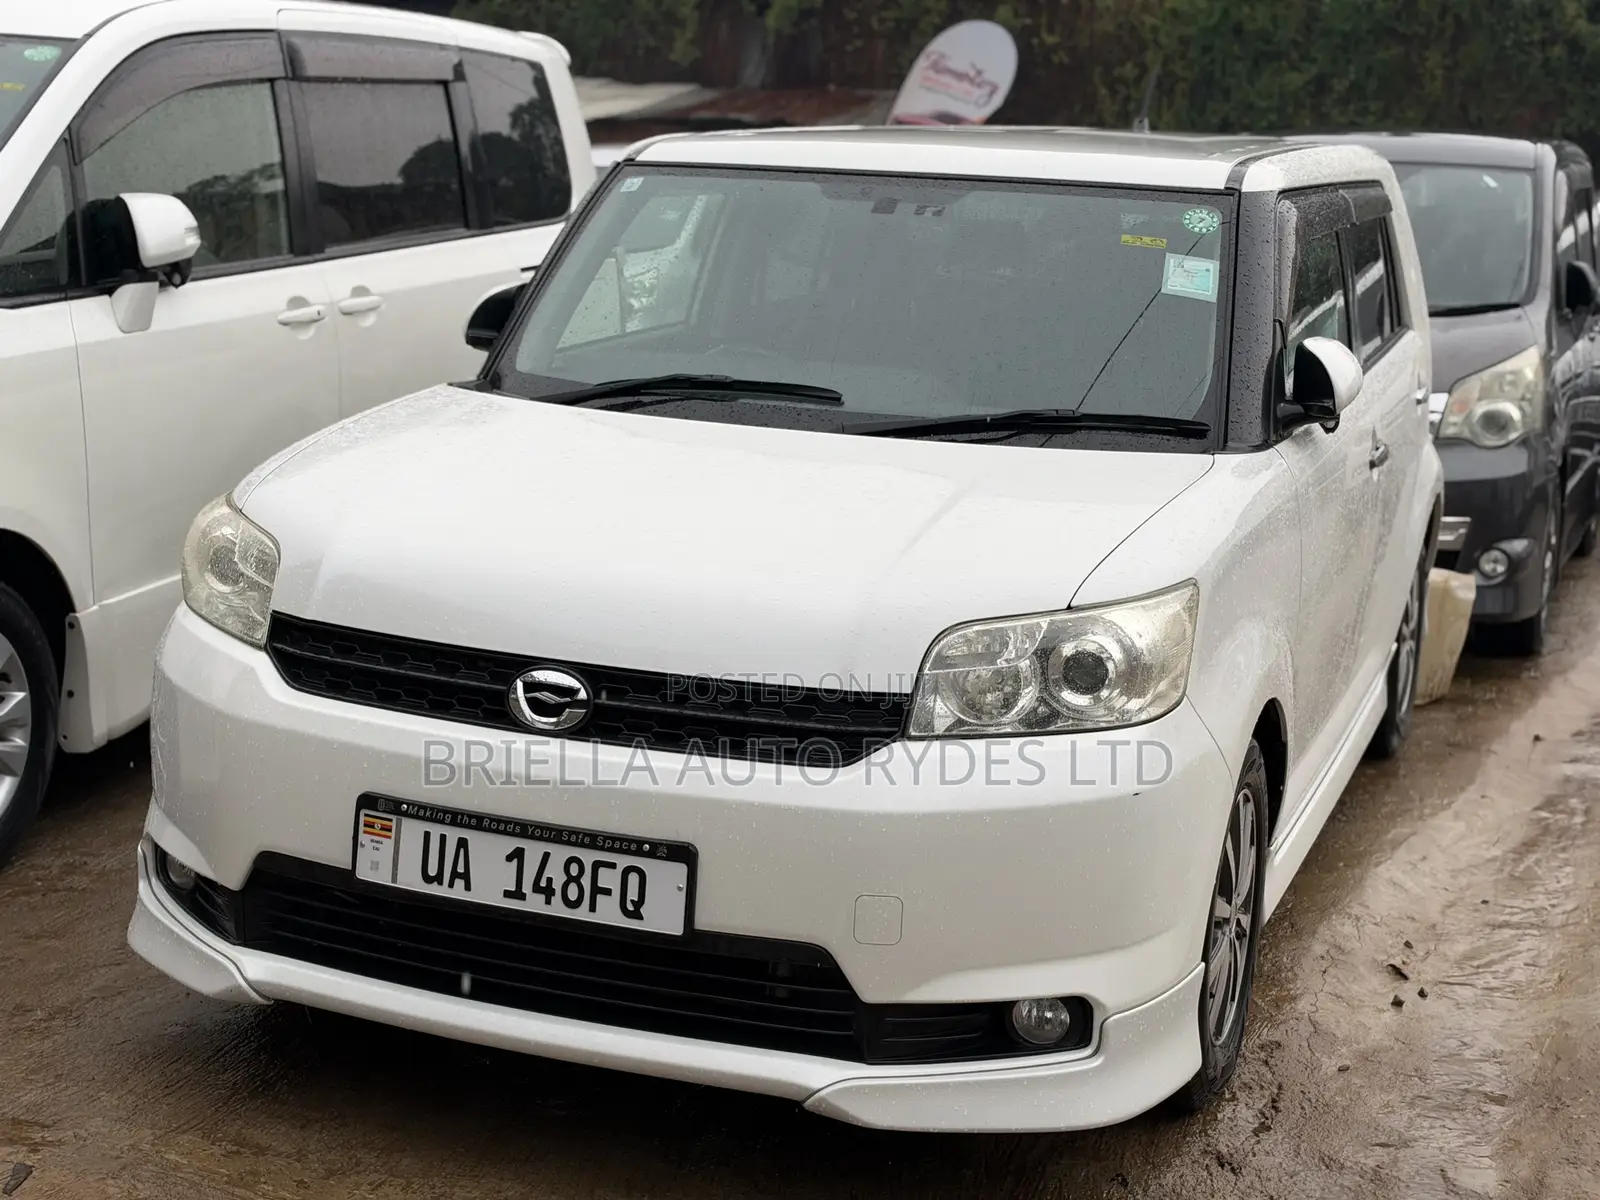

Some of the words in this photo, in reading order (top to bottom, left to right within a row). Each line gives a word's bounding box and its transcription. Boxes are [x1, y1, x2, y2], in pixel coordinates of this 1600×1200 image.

[407, 804, 452, 824] Making
[457, 814, 477, 826] the
[482, 818, 521, 833] Roads
[527, 825, 557, 838] Your
[561, 831, 591, 844] Safe
[596, 836, 637, 851] Space
[421, 830, 472, 892] UA
[503, 846, 647, 921] 148FQ
